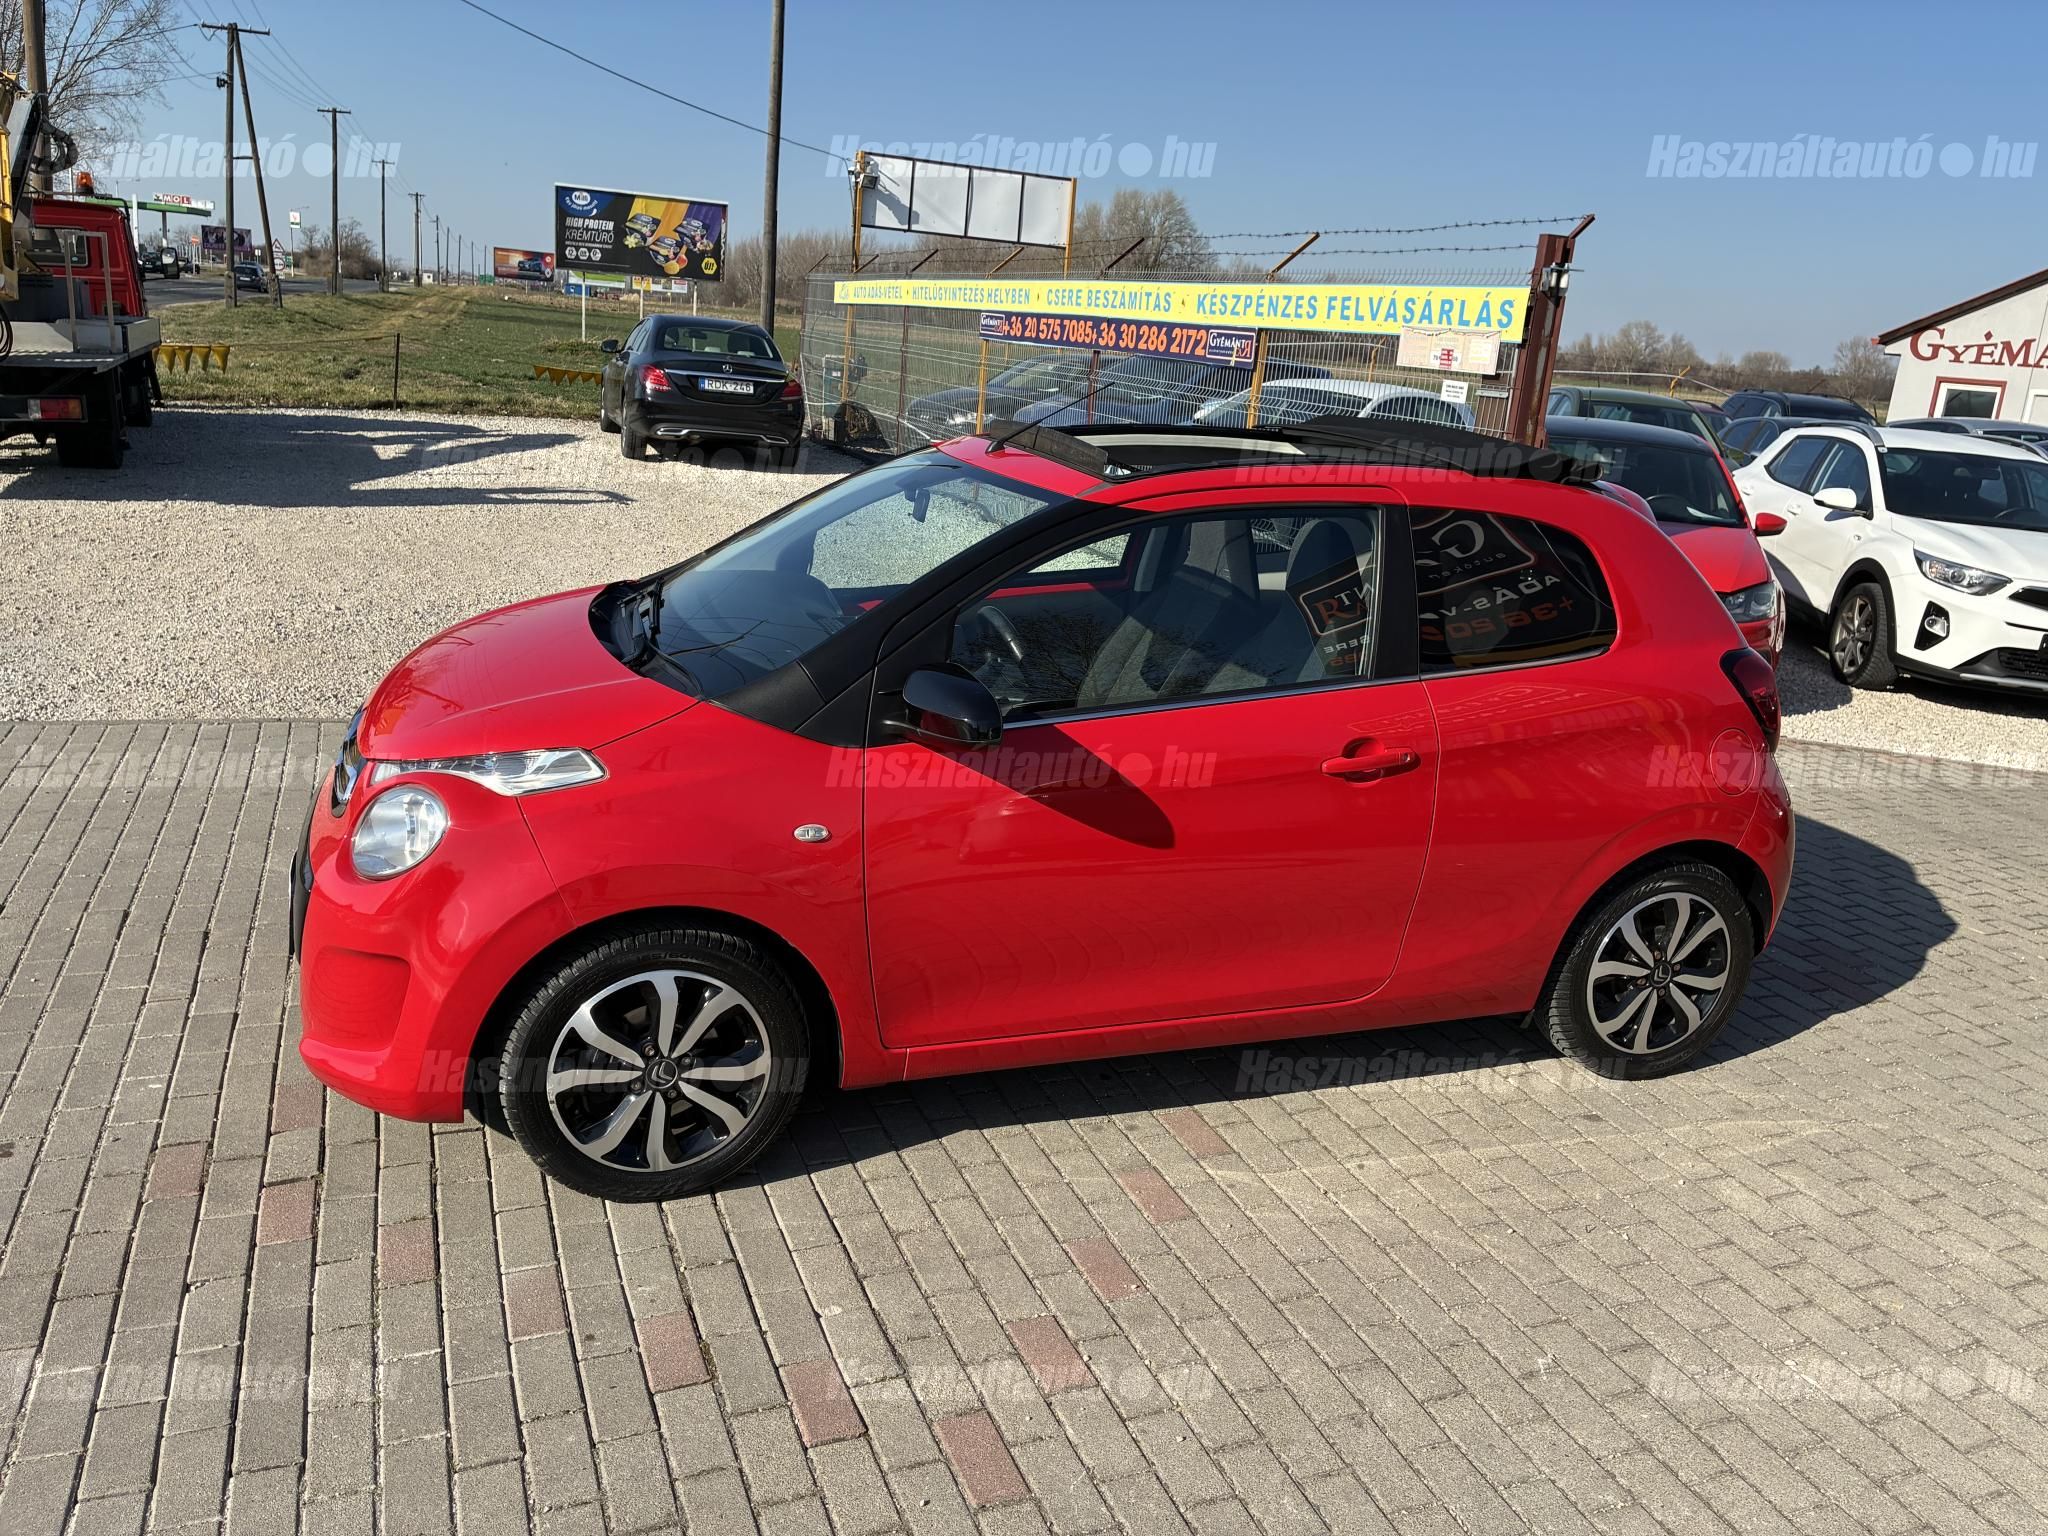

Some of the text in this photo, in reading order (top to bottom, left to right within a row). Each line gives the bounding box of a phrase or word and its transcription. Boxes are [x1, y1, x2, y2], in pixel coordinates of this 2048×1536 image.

[163, 194, 189, 205] MOL
[565, 217, 615, 230] HIGH PROTEIN
[565, 227, 615, 243] KRÉMTÚRÓ
[986, 287, 1030, 305] HELYBEN
[1047, 288, 1083, 307] CSERE
[1087, 286, 1172, 312] BESZÁMÍTÁS
[1196, 288, 1318, 319] KÉSZPÉNZES
[1326, 291, 1515, 328] FELVÁSÁRLÁS
[1024, 317, 1038, 338] 20
[1039, 318, 1061, 340] 575
[1063, 319, 1093, 344] 7085
[1119, 323, 1136, 349] 30
[1138, 325, 1168, 352] 286
[1169, 328, 1208, 356] 2172
